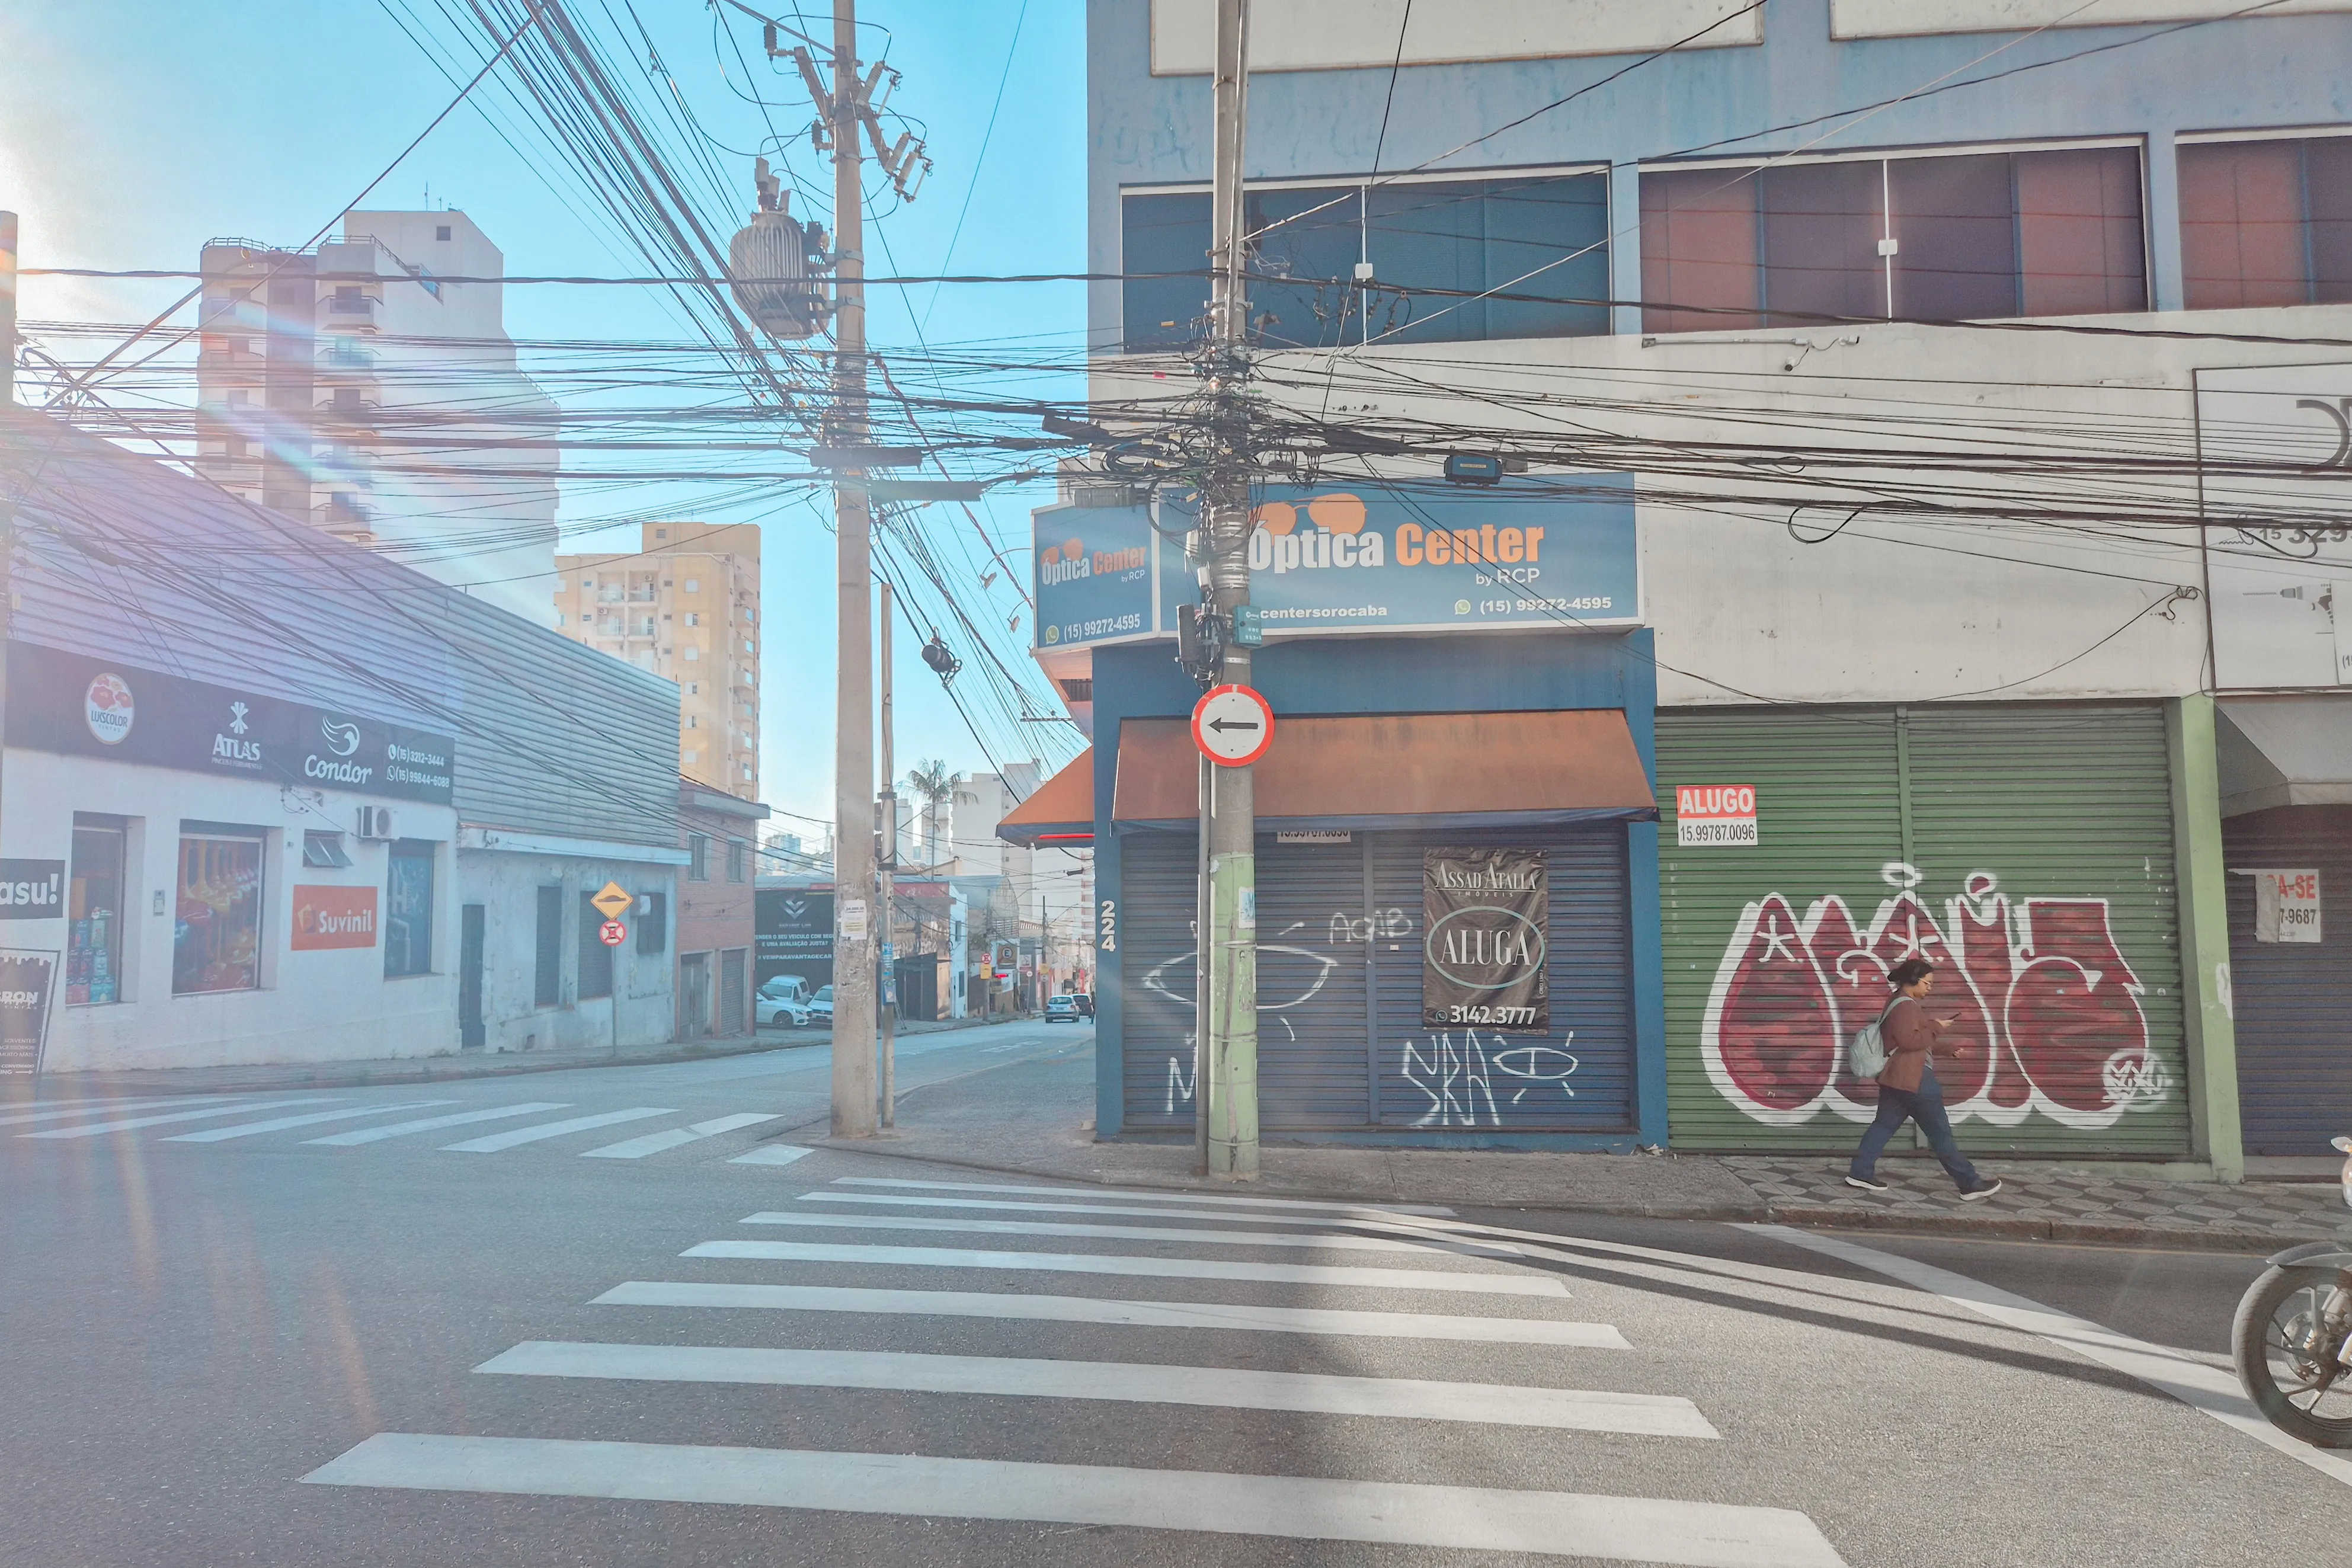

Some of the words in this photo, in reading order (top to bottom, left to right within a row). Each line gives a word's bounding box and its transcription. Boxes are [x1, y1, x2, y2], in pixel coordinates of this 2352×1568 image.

[1248, 519, 1384, 574] Óptica
[1396, 523, 1544, 565] Center
[1042, 555, 1090, 585] Óptica
[1093, 546, 1146, 575] Center
[1129, 569, 1145, 581] RCP
[1476, 572, 1493, 587] by
[1497, 568, 1540, 583] RCP
[1480, 599, 1512, 614] (15)
[1516, 597, 1611, 612] 99272-4595
[1064, 624, 1082, 642] (15)
[1085, 613, 1140, 636] 99272-4595
[91, 710, 128, 728] LUKSCOLOR
[213, 733, 260, 761] ATLAS
[397, 744, 410, 763] (15)
[410, 750, 444, 767] 3212-3444
[305, 754, 372, 784] Condor
[396, 766, 409, 784] (15)
[1680, 788, 1753, 814] ALUGO
[1681, 824, 1755, 841] 15.99787.0096
[319, 908, 372, 934] Suvinil
[1101, 900, 1116, 952] 224
[1439, 929, 1532, 967] ALUGA
[0, 991, 39, 1006] RON
[1450, 1005, 1537, 1025] 3142.3777
